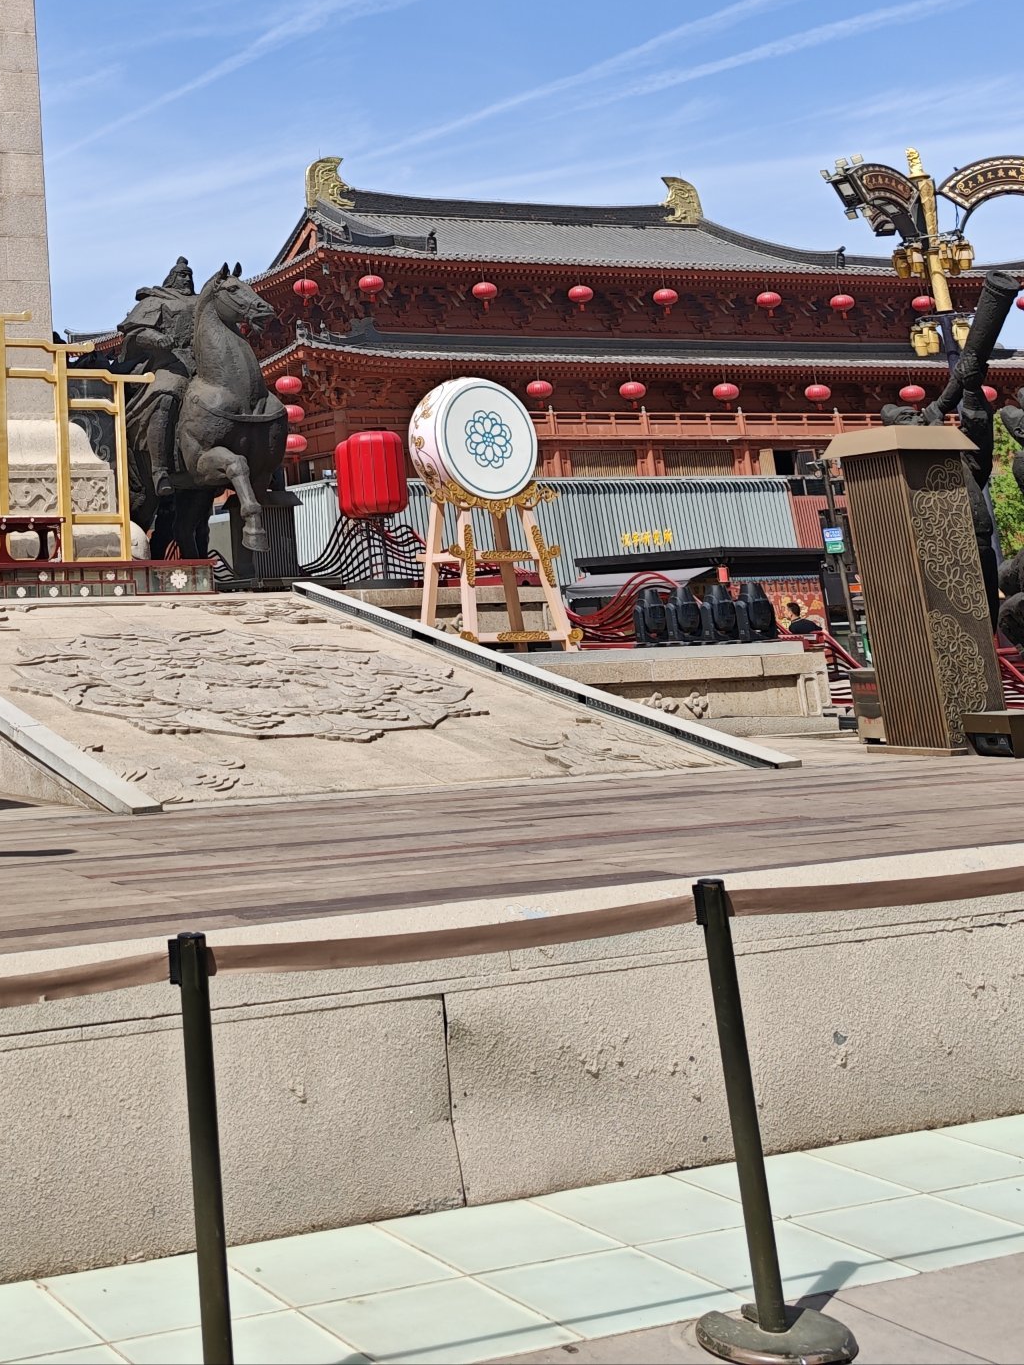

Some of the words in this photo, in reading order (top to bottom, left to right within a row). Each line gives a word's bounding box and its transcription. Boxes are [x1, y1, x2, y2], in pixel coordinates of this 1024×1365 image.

[967, 168, 1018, 188] 大唐不夜城
